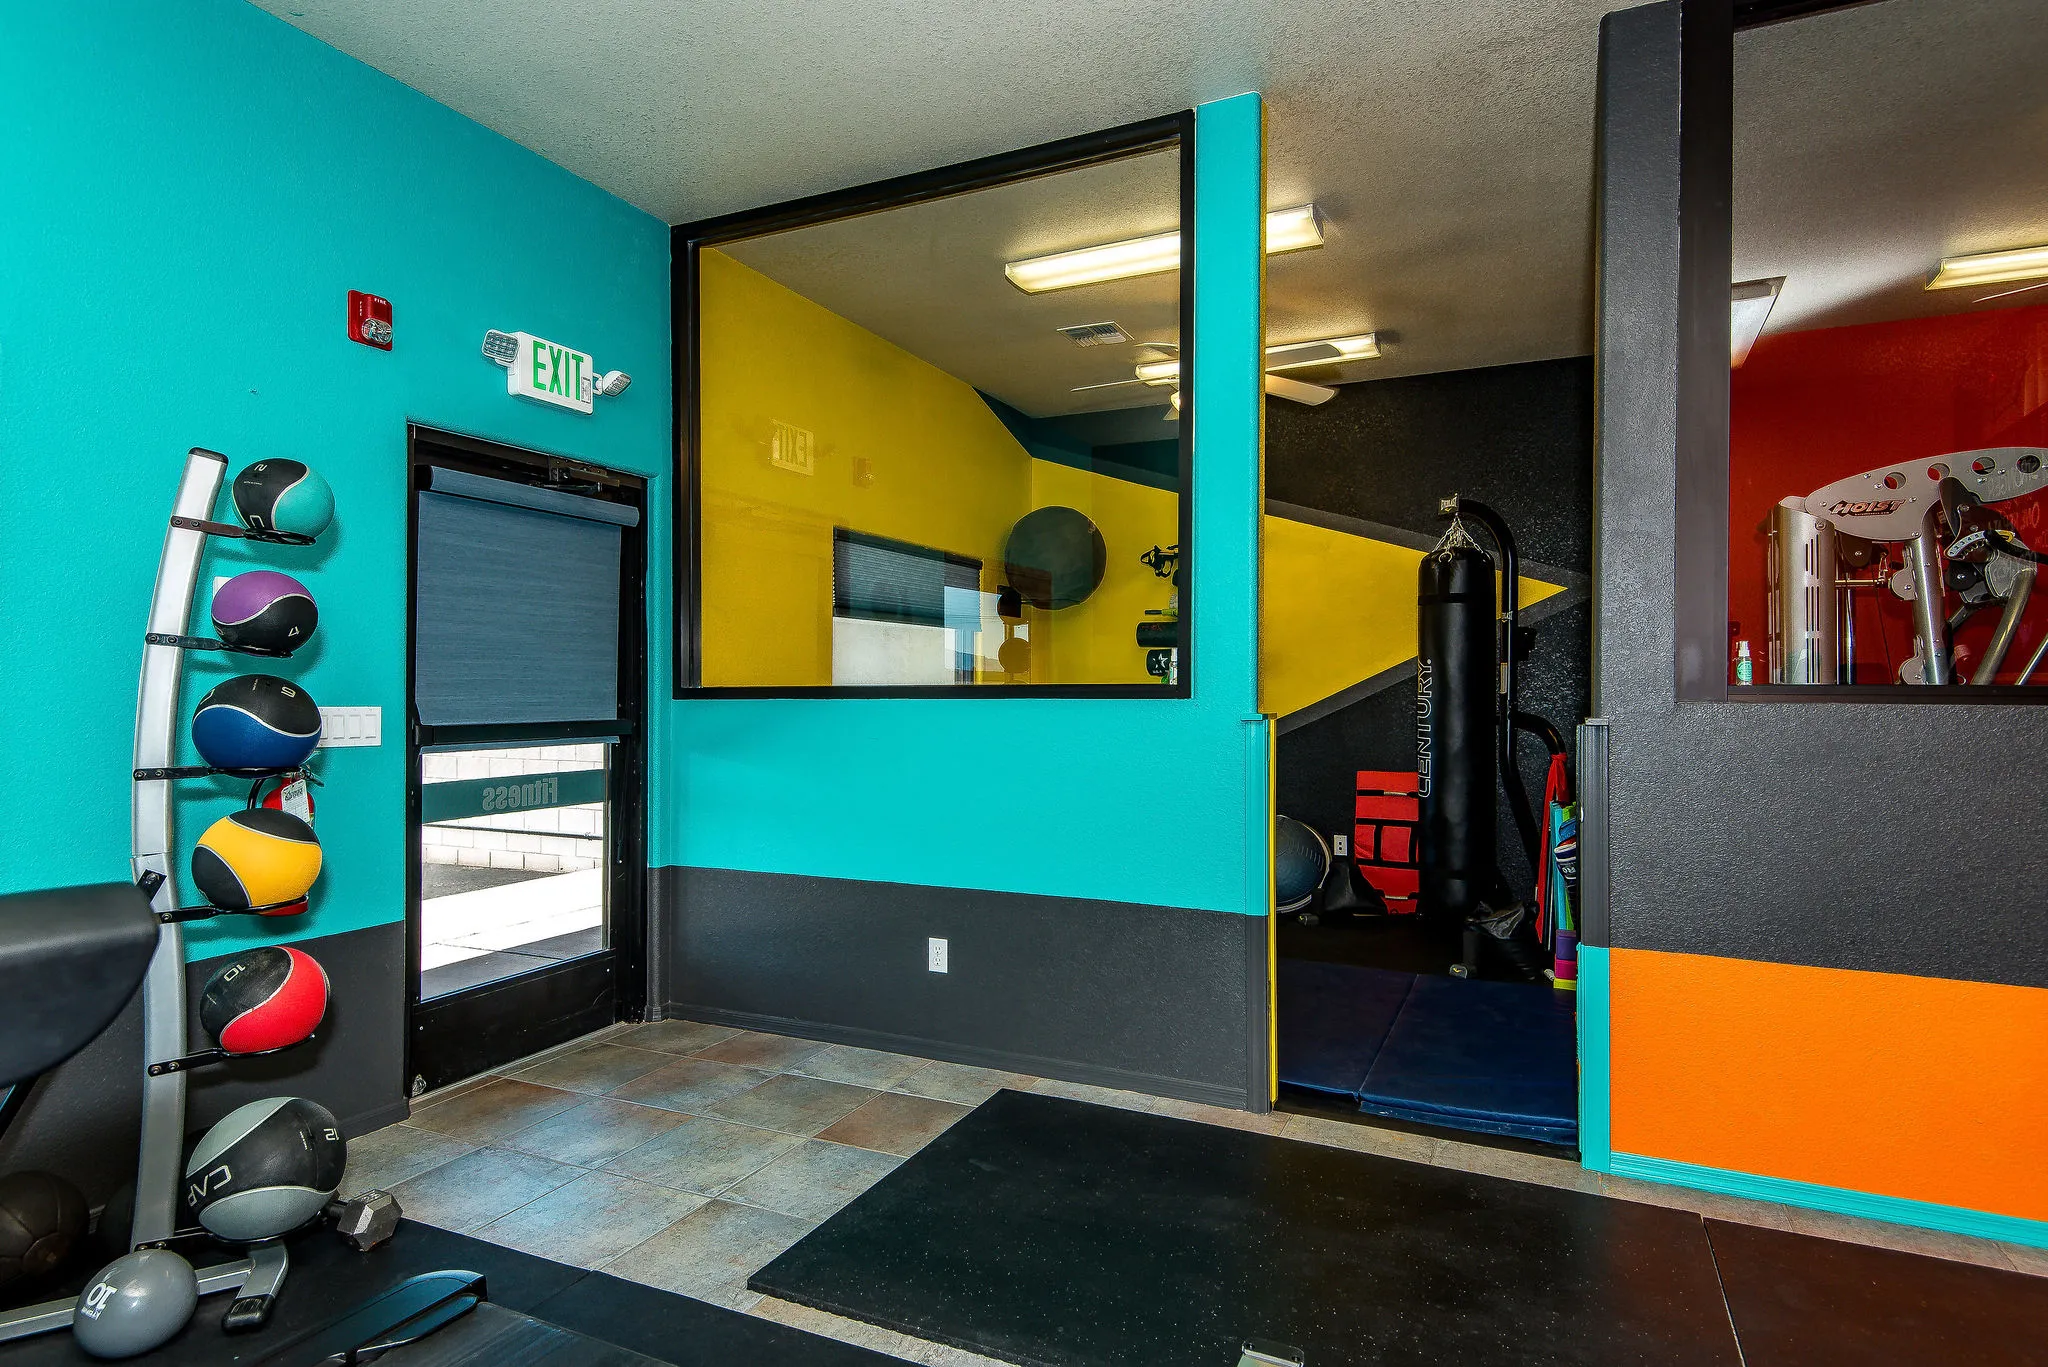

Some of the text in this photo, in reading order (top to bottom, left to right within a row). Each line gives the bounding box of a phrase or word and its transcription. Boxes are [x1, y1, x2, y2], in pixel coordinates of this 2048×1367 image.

[374, 297, 387, 306] FIRE
[533, 340, 584, 401] EXIT
[1832, 499, 1906, 514] HOIST
[223, 963, 246, 982] 10
[187, 1164, 232, 1207] CAP
[86, 1282, 118, 1310] 10
